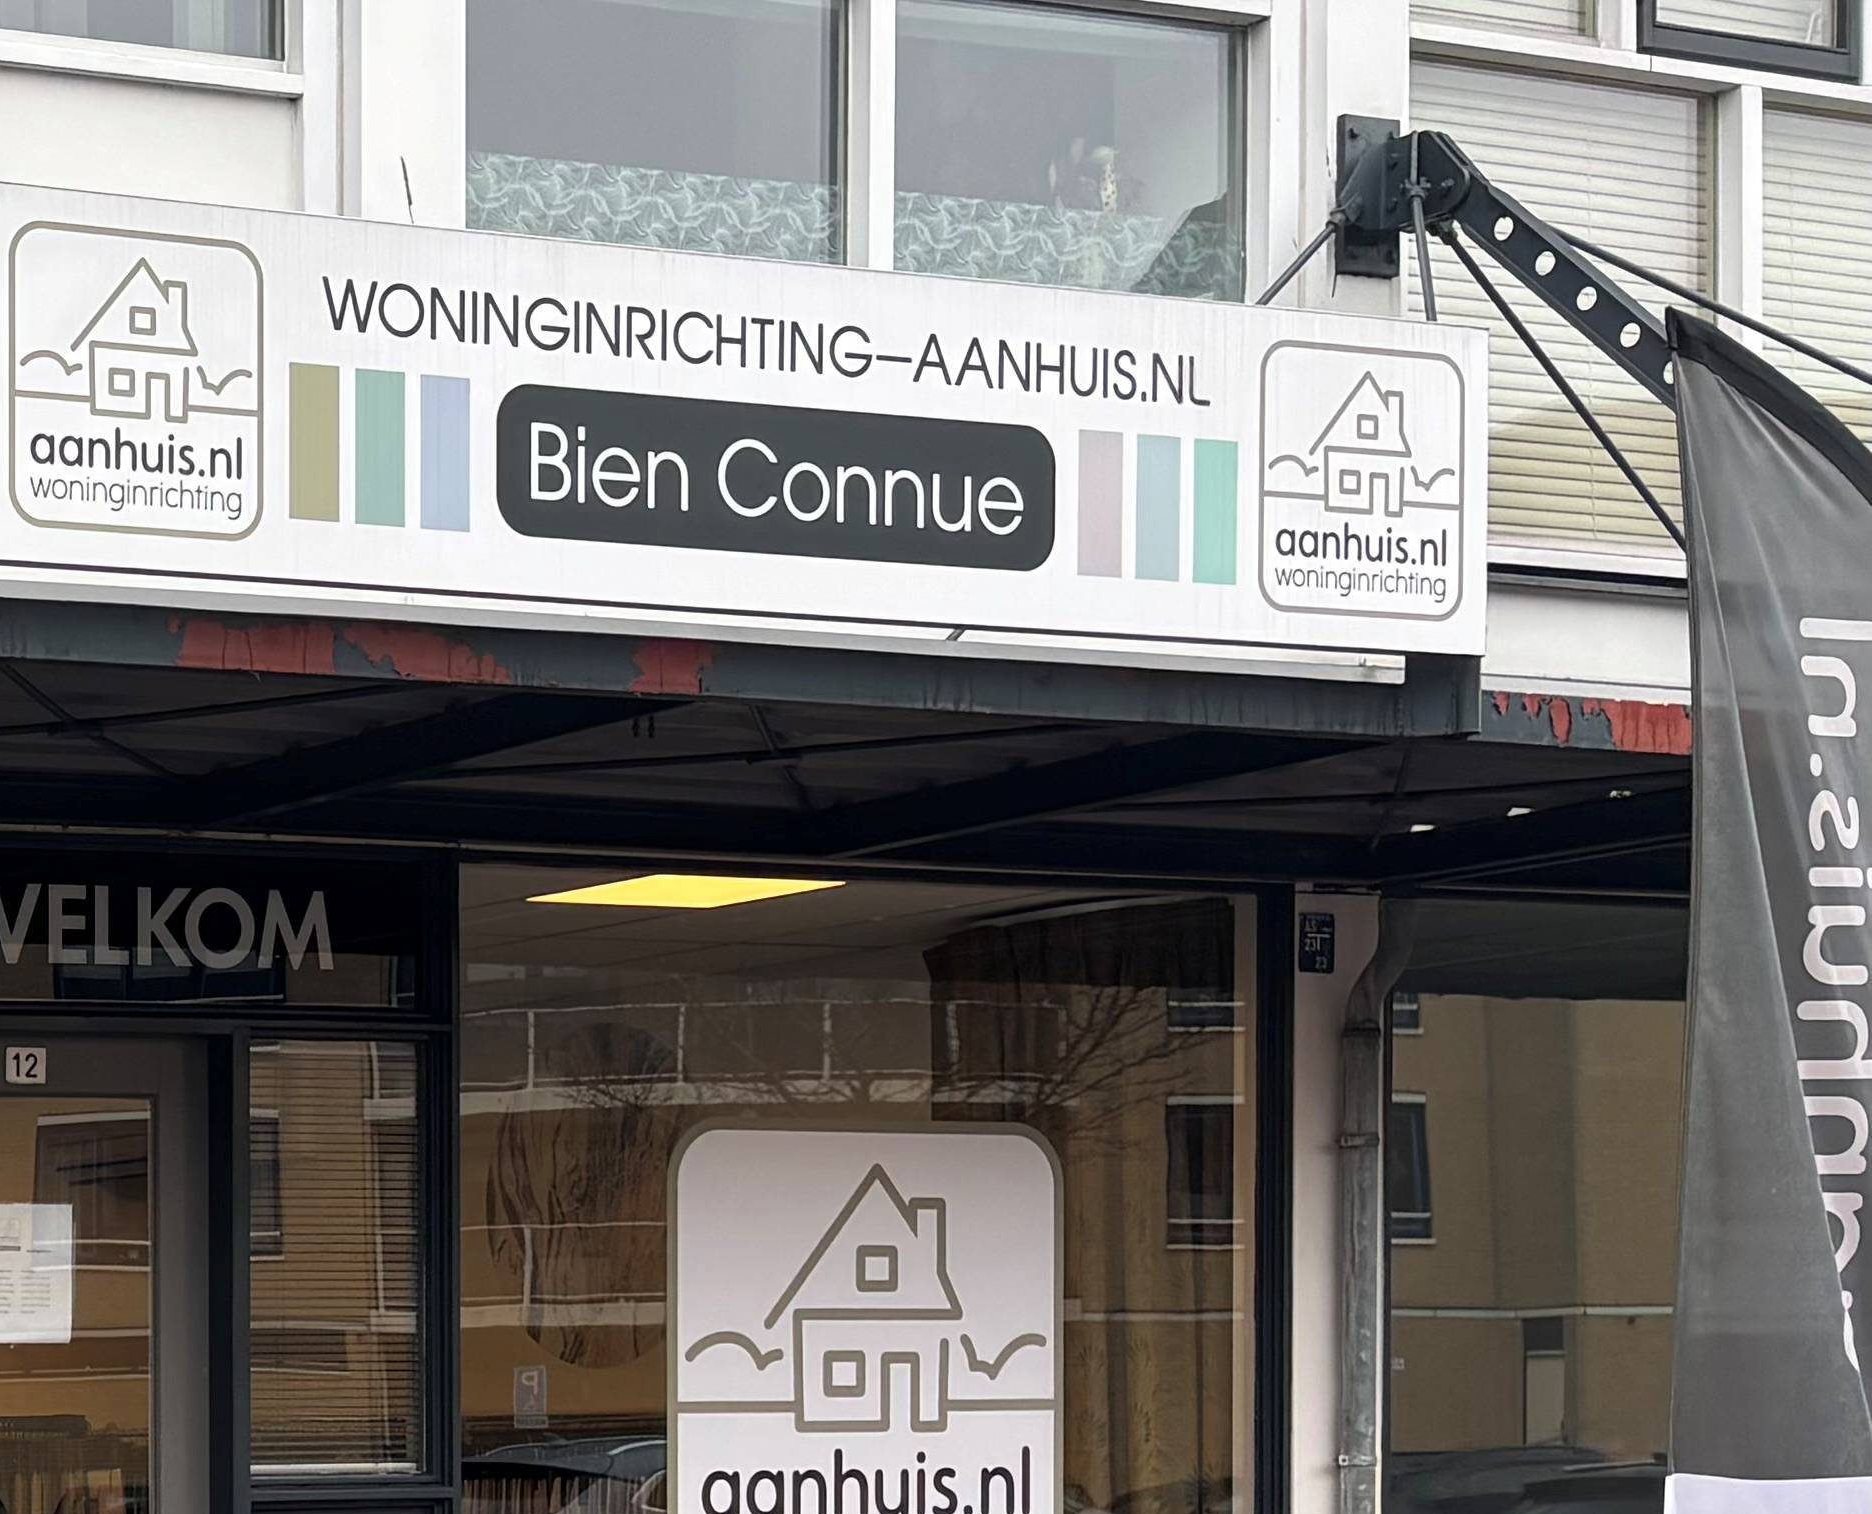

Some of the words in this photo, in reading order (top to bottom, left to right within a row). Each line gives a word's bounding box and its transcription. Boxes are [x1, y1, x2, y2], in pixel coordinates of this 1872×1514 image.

[30, 427, 243, 480] aanhuis.nl
[30, 476, 243, 521] woninginrichting
[531, 422, 688, 511] Bien
[718, 439, 1023, 535] Connue
[1275, 521, 1447, 567] aanhuis.nl
[1275, 565, 1447, 603] woninginrichting
[12, 1052, 38, 1080] 12
